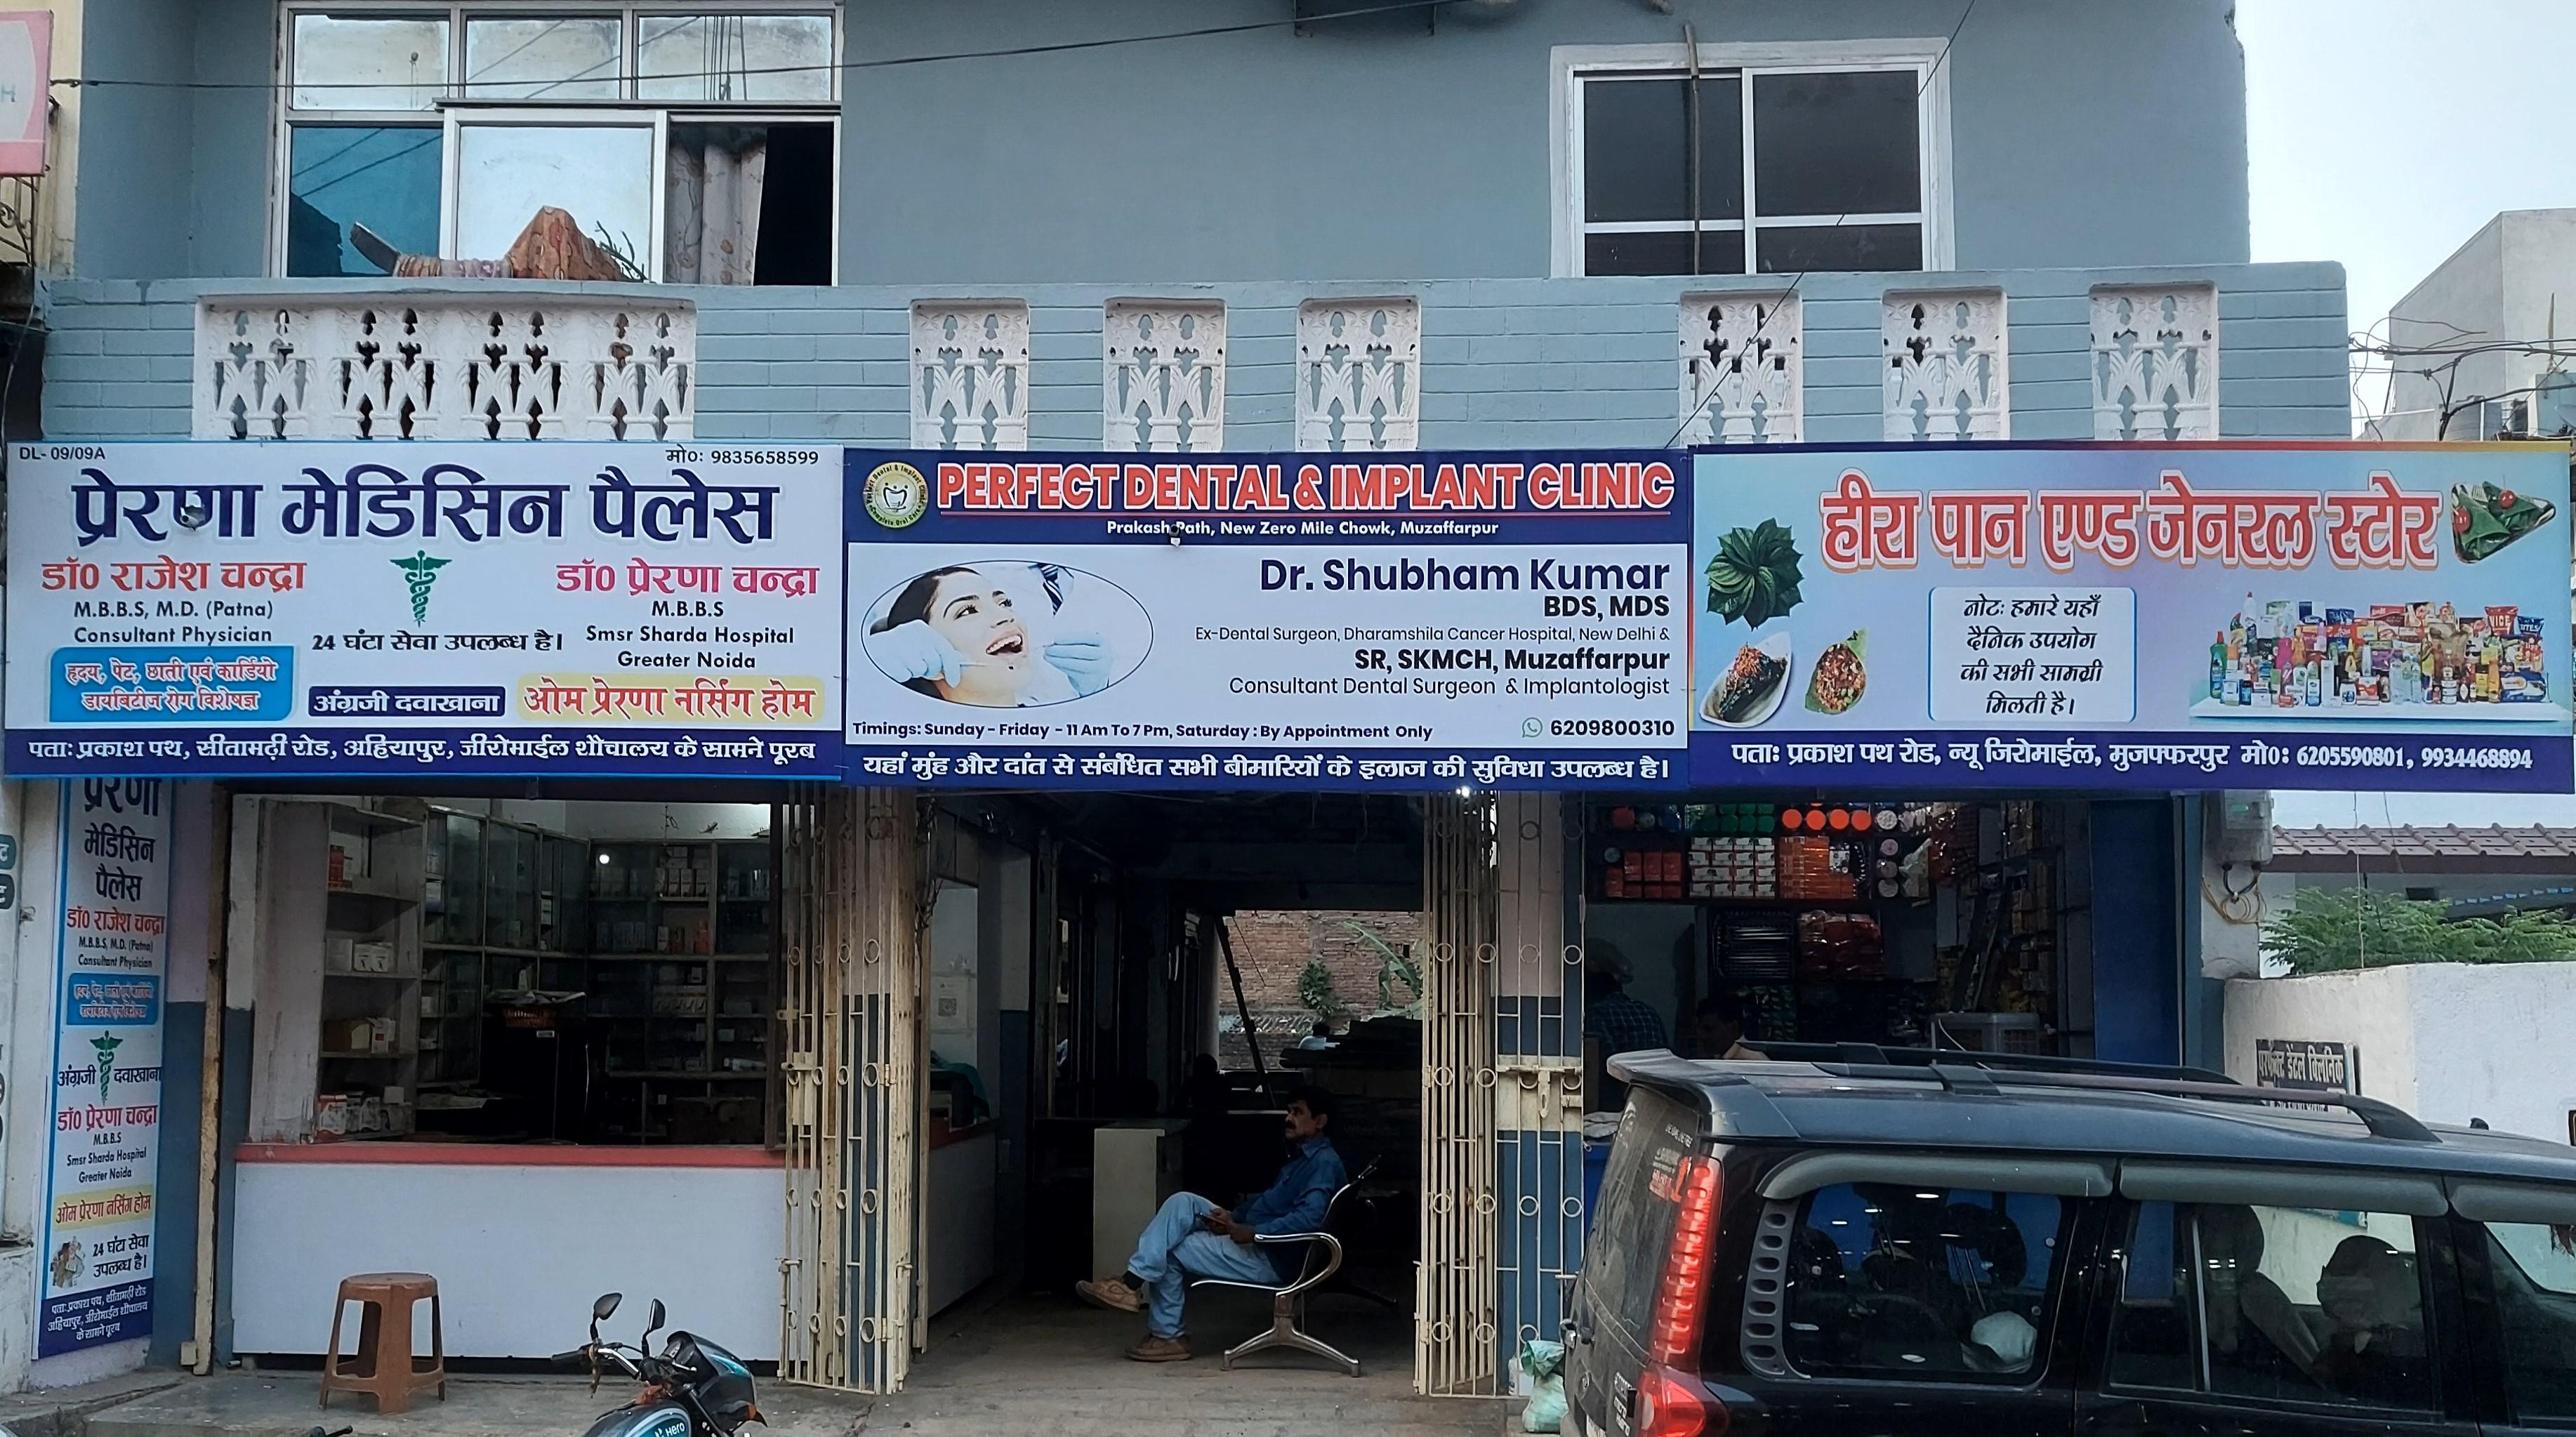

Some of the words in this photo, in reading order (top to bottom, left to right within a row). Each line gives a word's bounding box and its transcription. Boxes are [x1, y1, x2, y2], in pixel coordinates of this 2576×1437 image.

[19, 447, 46, 460] DL-
[51, 447, 105, 461] 09/09A
[711, 450, 819, 465] 9835658599
[937, 462, 1118, 509] PERFECT
[1124, 464, 1288, 509] DENTAL
[1294, 465, 1326, 509] &
[1330, 464, 1523, 510] IMPLANT
[1528, 462, 1674, 510] CLINIC
[72, 468, 263, 546] प्रेरणा
[282, 464, 570, 543] मेडिसिन
[590, 465, 780, 544] पैलेस
[1107, 520, 1170, 535] Prakash
[1220, 521, 1255, 535] New
[1259, 521, 1296, 535] Zero
[1301, 521, 1335, 535] Mile
[1338, 520, 1396, 536] Chowk,
[1401, 521, 1498, 537] Muzaffarpur
[1821, 470, 1920, 566] हीरा
[1930, 492, 2030, 565] पान
[2039, 492, 2142, 570] एण्ड
[2147, 472, 2320, 566] जेनरल
[2327, 472, 2442, 566] स्टोर
[110, 555, 211, 592] राजेश
[220, 562, 307, 592] चन्द्रा
[627, 557, 722, 596] प्रेरणा
[733, 566, 819, 598] चन्द्रा
[1261, 559, 1313, 590] Dr.
[1324, 558, 1519, 591] Shubham
[1531, 558, 1670, 591] Kumar
[74, 601, 149, 619] M.B.B.S,
[156, 601, 199, 618] M.D.
[206, 600, 273, 619] (Patna)
[652, 601, 723, 616] M.B.B.S
[1545, 596, 1603, 621] BDS,
[1610, 596, 1669, 616] MDS
[2011, 595, 2059, 616] हमारे
[2064, 593, 2101, 617] यहाँ
[74, 626, 176, 643] Consultant
[182, 626, 272, 646] Physician
[312, 635, 336, 650] 24
[343, 629, 384, 650] घंटा
[390, 630, 439, 650] सेवा
[445, 634, 528, 651] उपलब्ध
[586, 625, 633, 642] Smsr
[640, 626, 707, 643] Sharda
[714, 626, 793, 646] Hospital
[1196, 627, 1269, 641] Ex-Dental
[1273, 628, 1340, 644] Surgeon,
[1344, 628, 1444, 642] Dharamshila
[1447, 628, 1505, 641] Cancer
[1510, 628, 1575, 644] Hospital,
[1579, 628, 1612, 640] New
[1617, 627, 1656, 640] Delhi
[1659, 628, 1669, 640] &
[1967, 626, 2025, 650] दैनिक
[2029, 626, 2097, 650] उपयोग
[618, 651, 689, 668] Greater
[697, 651, 756, 668] Noida
[1355, 650, 1393, 674] SR,
[1398, 649, 1498, 674] SKMCH,
[1505, 647, 1670, 675] Muzaffarpur
[1960, 659, 1988, 681] की
[1993, 659, 2035, 681] सभी
[2040, 660, 2103, 683] सामग्री
[66, 663, 106, 684] हृदय,
[111, 658, 140, 684] पेट,
[146, 657, 184, 682] छाती
[187, 658, 214, 686] एवं
[217, 657, 277, 683] कार्डियो
[524, 677, 588, 715] ओम
[590, 677, 668, 719] प्रेरणा
[675, 677, 754, 718] नर्सिंग
[762, 679, 817, 719] होम
[1229, 678, 1337, 694] Consultant
[1344, 677, 1407, 694] Dental
[1413, 678, 1495, 698] Surgeon
[1506, 679, 1518, 694] &
[1524, 677, 1669, 699] Implantologist
[82, 689, 163, 710] डायबिटीज
[164, 690, 194, 713] रोग
[197, 689, 260, 712] विशेषज्ञ
[395, 695, 501, 713] दवाखाना
[1986, 691, 2046, 714] मिलती
[853, 722, 920, 737] Timings:
[925, 723, 984, 739] Sunday
[999, 724, 1048, 739] Friday
[1067, 724, 1078, 736] 11
[1081, 724, 1108, 736] Am
[1111, 724, 1129, 736] To
[1132, 724, 1140, 736] 7
[1144, 724, 1173, 739] Pm,
[1176, 724, 1249, 740] Saturday
[1260, 725, 1280, 741] By
[1283, 725, 1389, 741] Appointment
[1396, 725, 1432, 741] Only
[1550, 720, 1675, 736] 6209800310
[76, 741, 143, 759] प्रकाश
[150, 742, 190, 760] पथ,
[292, 735, 337, 759] रोड,
[344, 735, 454, 762] अहियापुर,
[675, 736, 696, 757] के
[701, 737, 764, 758] सामने
[769, 743, 816, 764] पूरब
[1787, 744, 1854, 765] प्रकाश
[1859, 744, 1894, 763] पथ
[1899, 739, 1941, 765] रोड,
[1948, 745, 1983, 769] न्यू
[2109, 745, 2229, 771] मुजफ्फरपुर
[2297, 746, 2413, 769] 6205590801,
[2422, 748, 2532, 769] 9934468894
[864, 752, 907, 774] यहां
[912, 753, 950, 780] मुंह
[956, 753, 999, 774] और
[1004, 752, 1047, 775] दांत
[1052, 753, 1074, 775] से
[1169, 753, 1217, 776] सभी
[1223, 752, 1325, 776] बीमारियों
[1328, 755, 1352, 776] के
[1359, 760, 1426, 778] इलाज
[1433, 755, 1466, 777] की
[1472, 755, 1545, 783] सुविधा
[1550, 760, 1634, 778] उपलब्ध
[84, 823, 156, 863] मेडिसिन
[95, 863, 143, 902] पैलेस
[93, 907, 131, 933] राजेश
[135, 915, 166, 934] चन्द्रा
[110, 938, 126, 951] M.D.
[78, 954, 117, 967] Consultant
[119, 956, 152, 970] Physician
[114, 1066, 161, 1082] दवाखाना
[86, 1104, 121, 1131] प्रेरणा
[126, 1104, 157, 1126] चन्द्रा
[93, 1133, 121, 1145] M.B.B.S
[67, 1153, 86, 1166] Smsr
[88, 1151, 114, 1164] Sharda
[117, 1147, 146, 1162] Hospital
[79, 1170, 107, 1183] Greater
[110, 1167, 131, 1180] Noida
[56, 1201, 77, 1224] ओम
[133, 1193, 151, 1212] होम
[129, 1233, 150, 1250] सेवा
[665, 1422, 685, 1436] Hero
